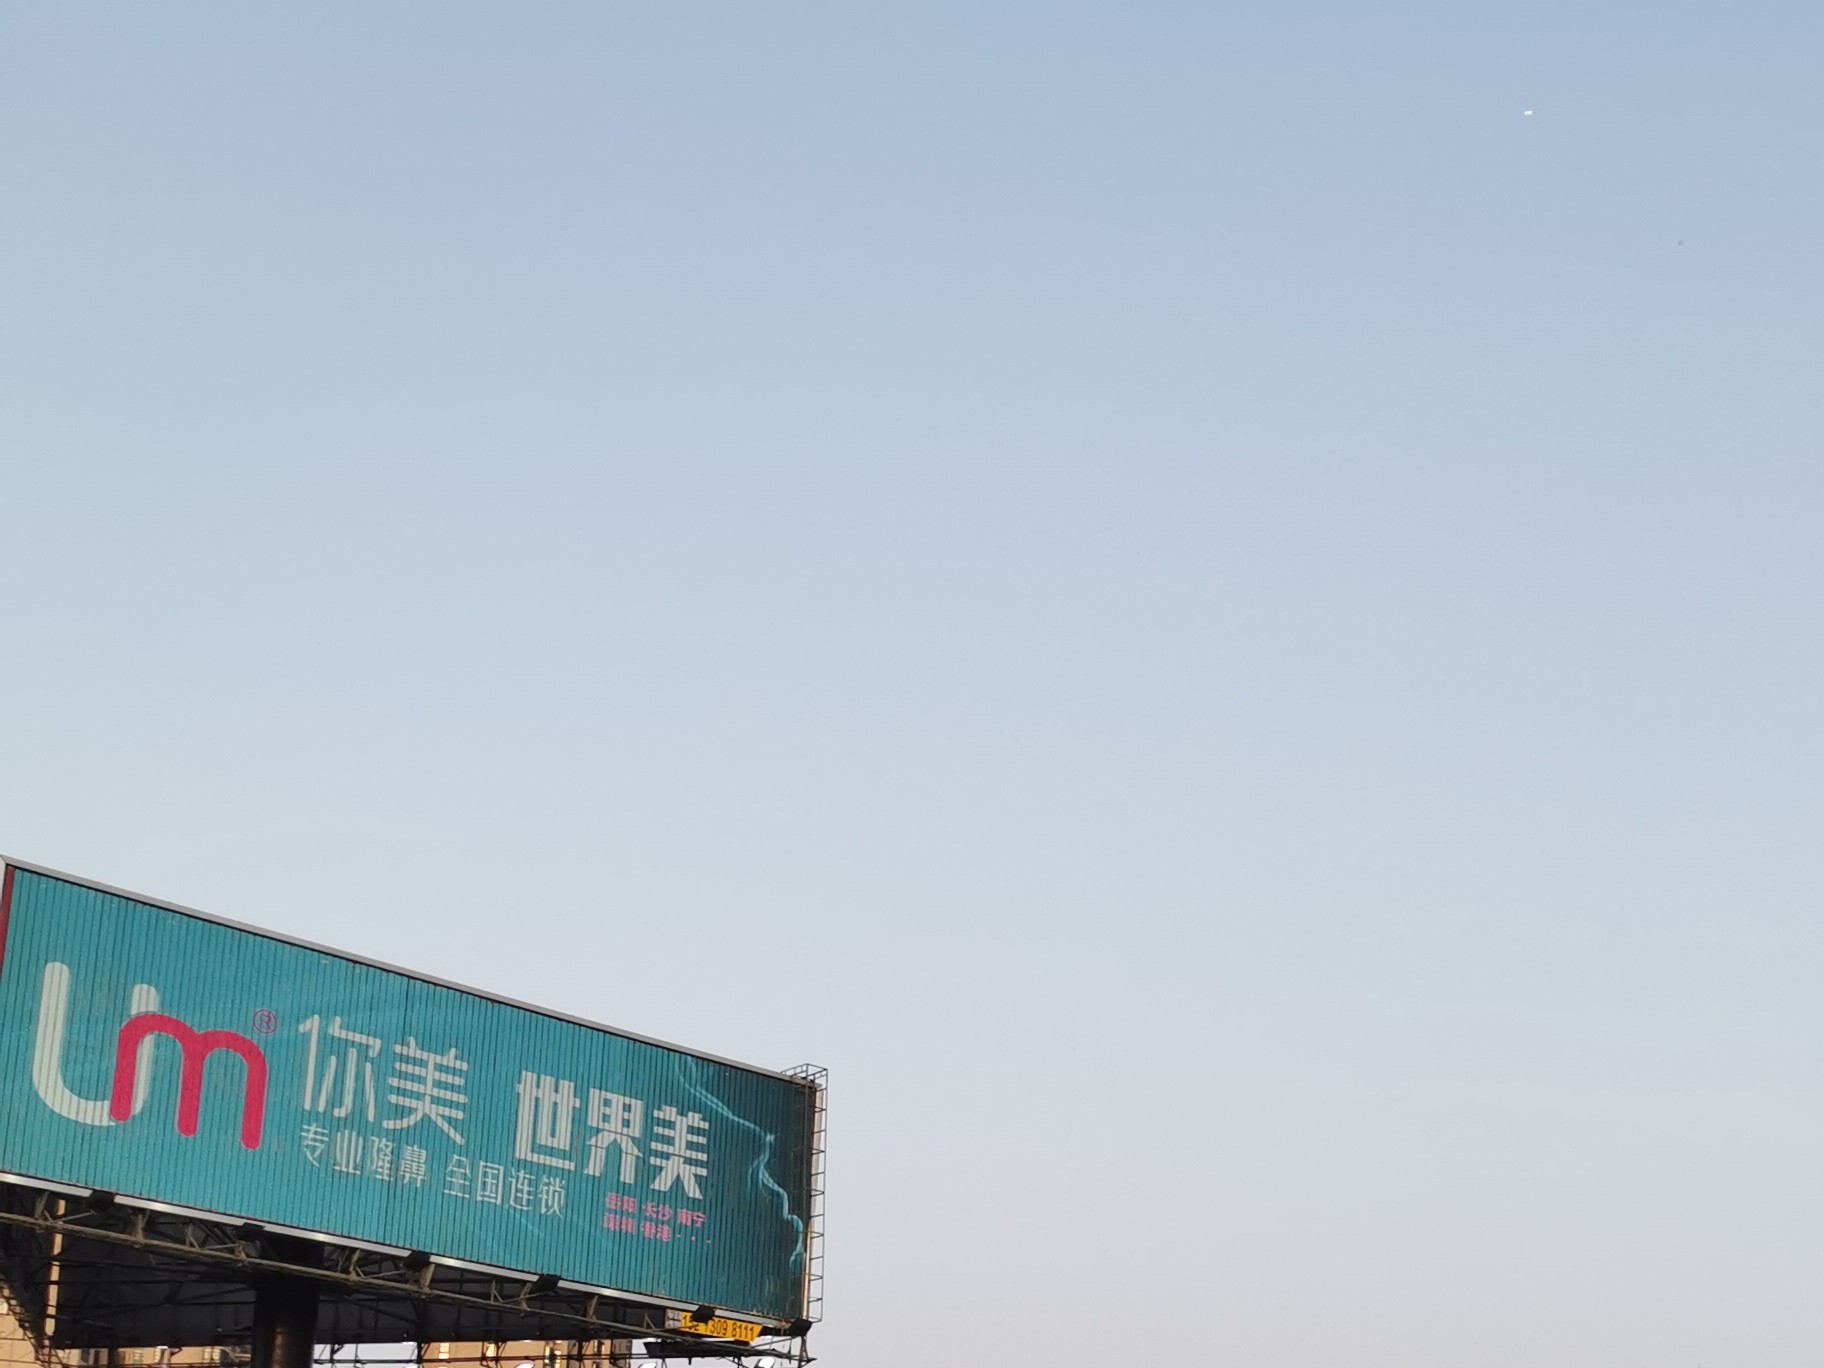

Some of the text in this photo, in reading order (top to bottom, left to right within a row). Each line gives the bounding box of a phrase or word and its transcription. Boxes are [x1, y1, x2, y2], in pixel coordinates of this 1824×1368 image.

[298, 1014, 710, 1200] 你美 世界美
[300, 1121, 567, 1219] 专业隆鼻 全国连锁
[731, 1321, 755, 1341] 8111
